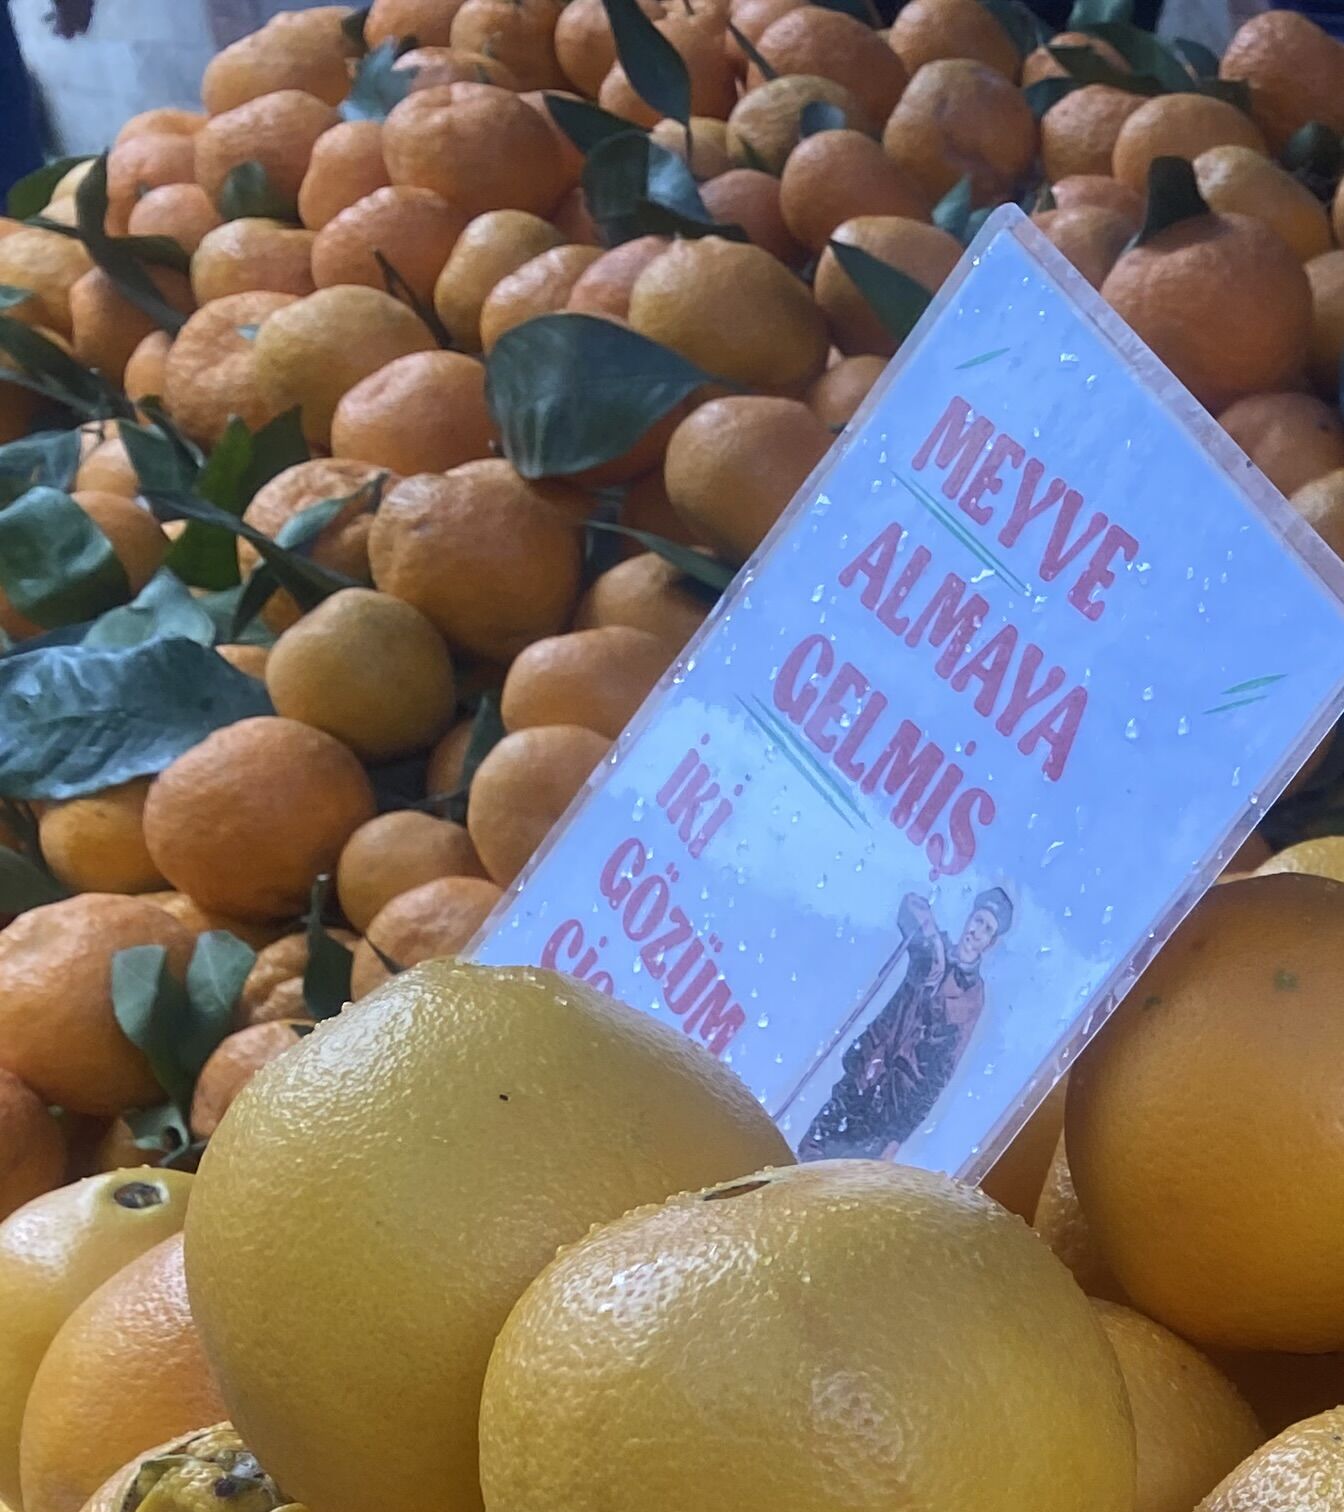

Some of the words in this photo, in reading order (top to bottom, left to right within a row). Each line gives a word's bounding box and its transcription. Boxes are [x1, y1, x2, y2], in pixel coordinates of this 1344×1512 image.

[911, 396, 1140, 622] MEYVE
[773, 634, 997, 882] GELMİŞ
[838, 522, 1088, 783] ALMAYA
[656, 732, 744, 860] İKİ
[601, 837, 747, 1057] GÖZÜM
